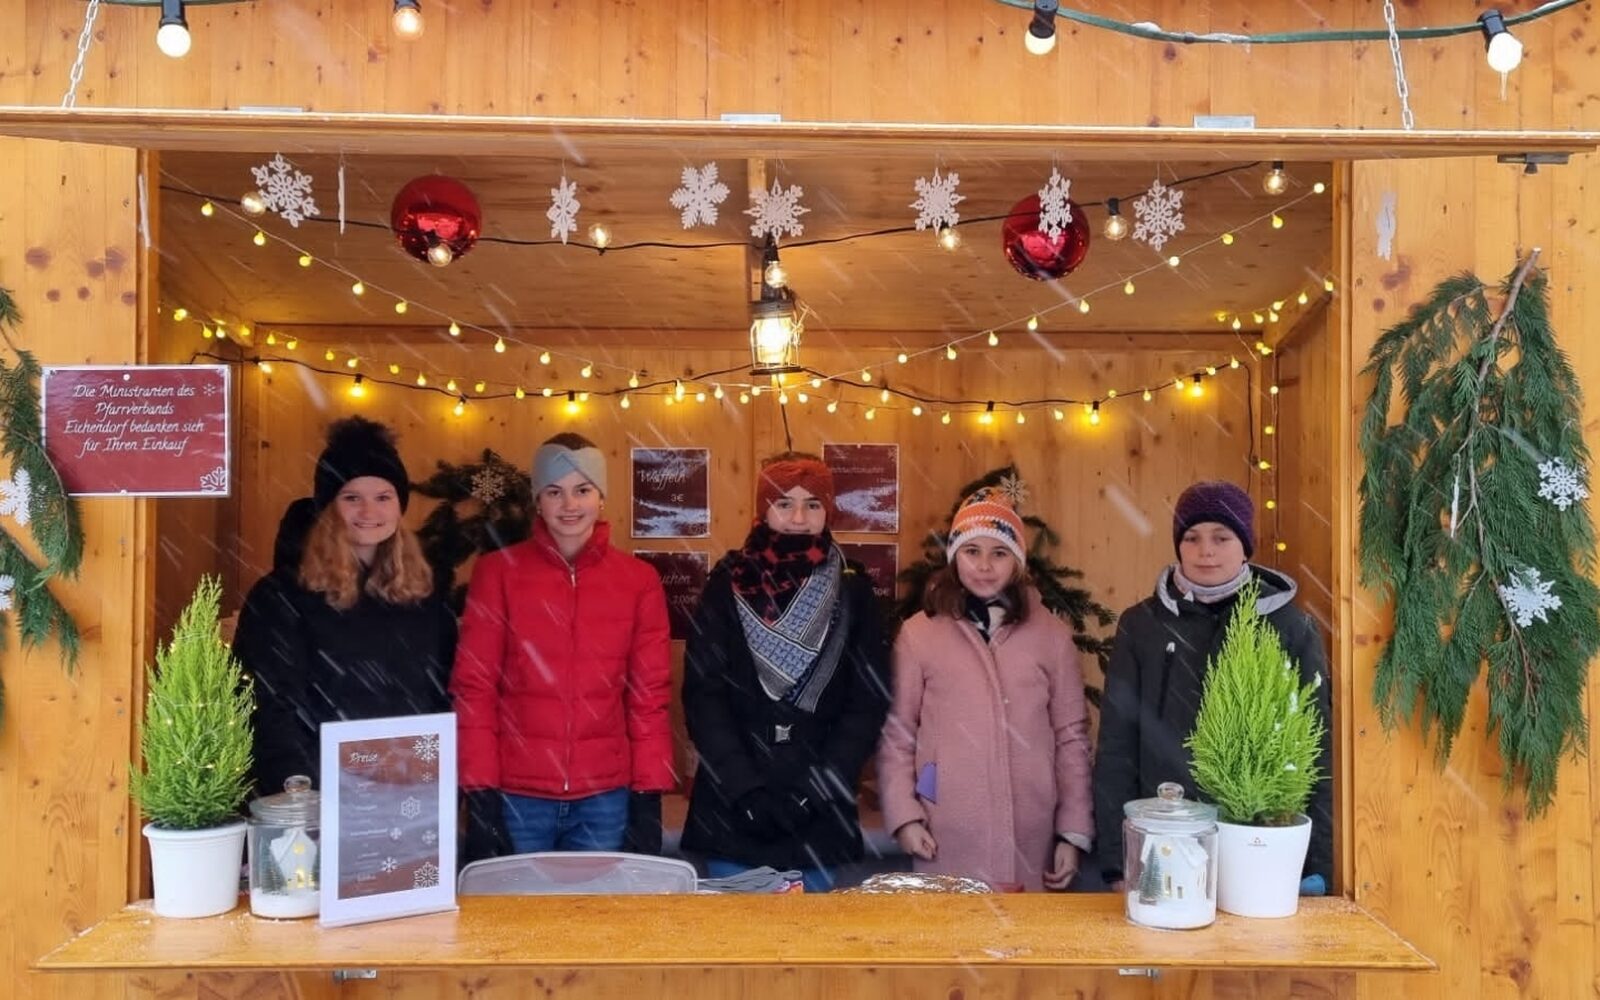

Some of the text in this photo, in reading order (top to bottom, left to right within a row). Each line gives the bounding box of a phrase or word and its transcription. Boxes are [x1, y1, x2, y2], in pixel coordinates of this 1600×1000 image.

[73, 384, 195, 398] Die Ministranten des
[94, 402, 175, 422] Pfarrverbands
[64, 419, 205, 439] Eichendorf bedanken sich
[74, 436, 189, 459] für Ihren Einkauf
[637, 467, 687, 490] Waffeln
[660, 570, 691, 585] uchen
[350, 751, 378, 763] Preise
